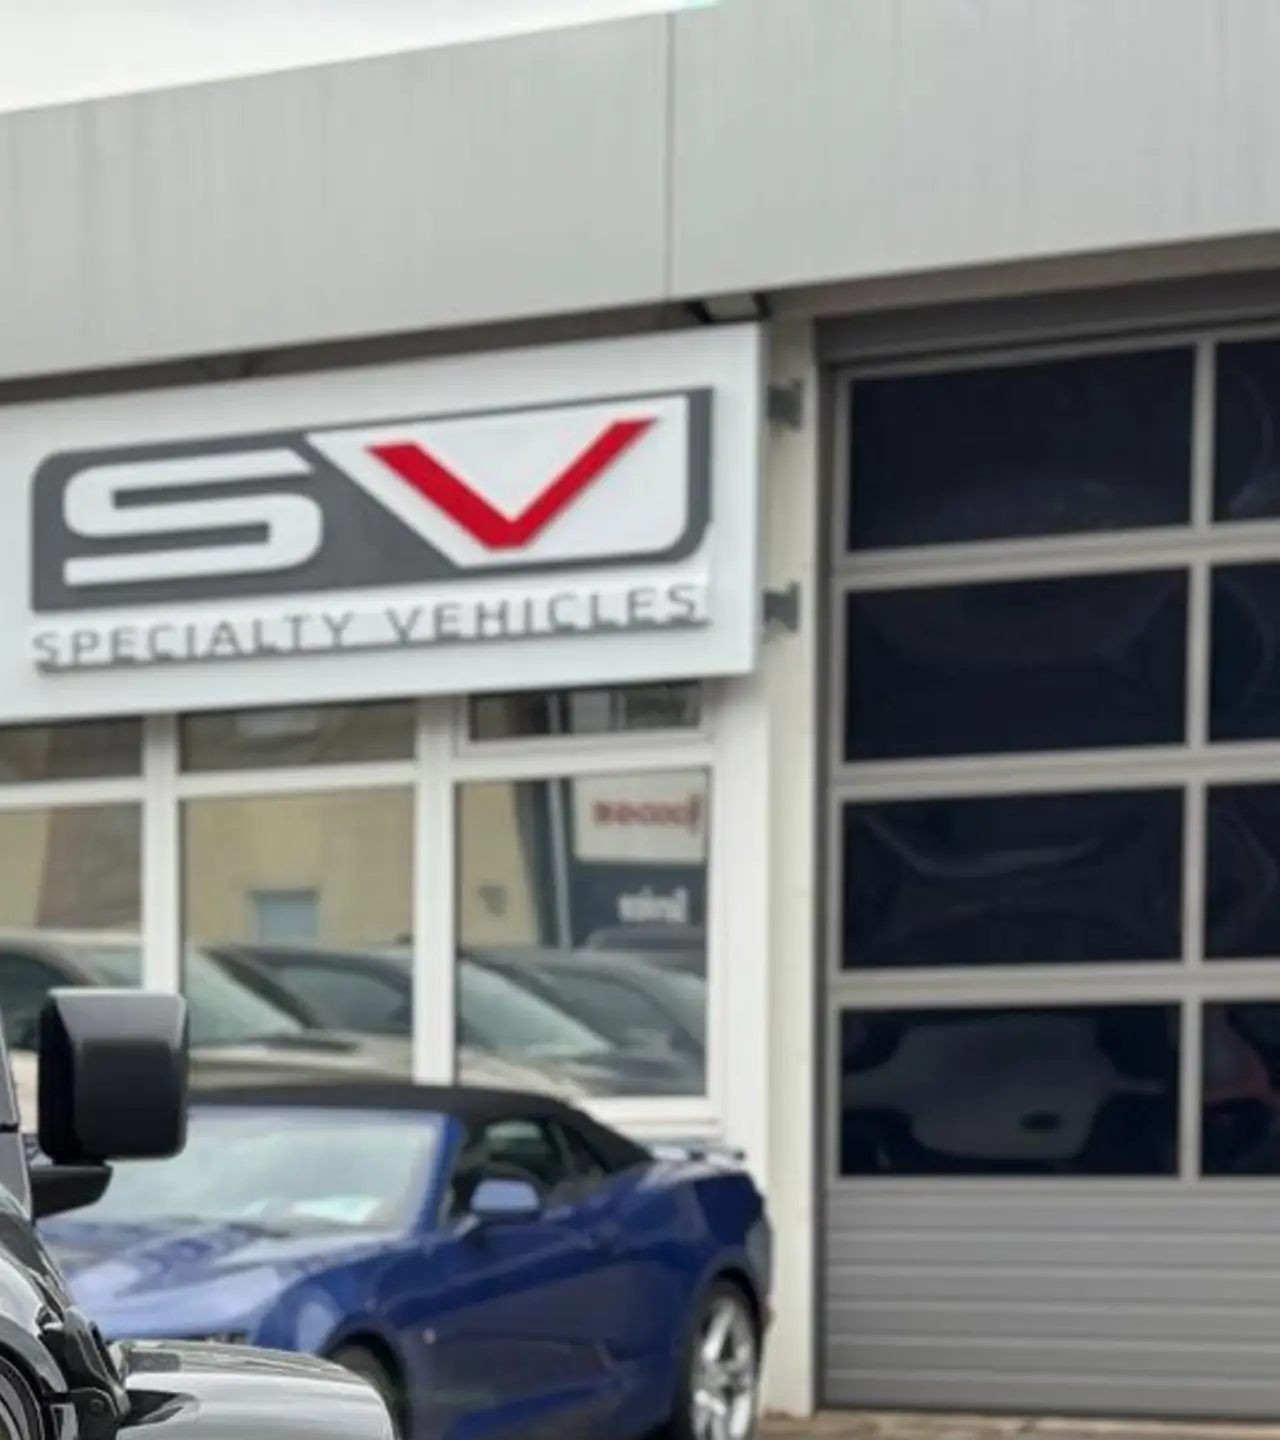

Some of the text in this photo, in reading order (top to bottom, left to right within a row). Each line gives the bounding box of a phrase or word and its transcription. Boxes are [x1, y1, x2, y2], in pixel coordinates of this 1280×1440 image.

[62, 416, 662, 587] SV
[31, 582, 702, 668] SPECIALTY VEHICLES
